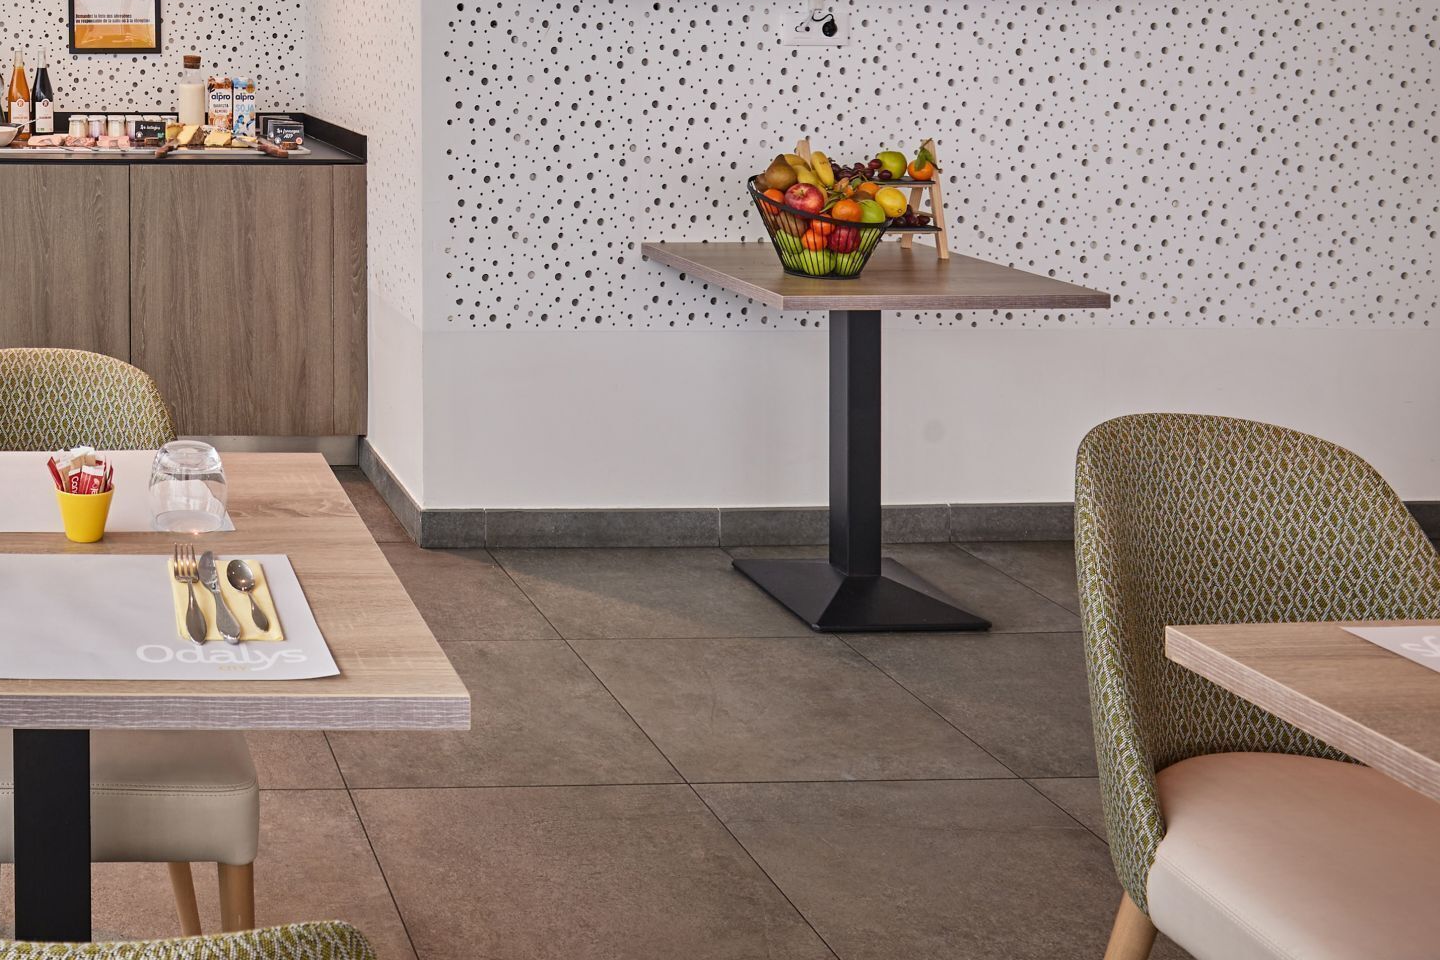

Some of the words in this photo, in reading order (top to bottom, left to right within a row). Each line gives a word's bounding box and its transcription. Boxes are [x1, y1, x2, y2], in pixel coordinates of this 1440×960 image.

[211, 93, 231, 101] alpro
[235, 93, 255, 102] alpro
[235, 104, 255, 113] SOJA
[136, 642, 308, 671] Odalys
